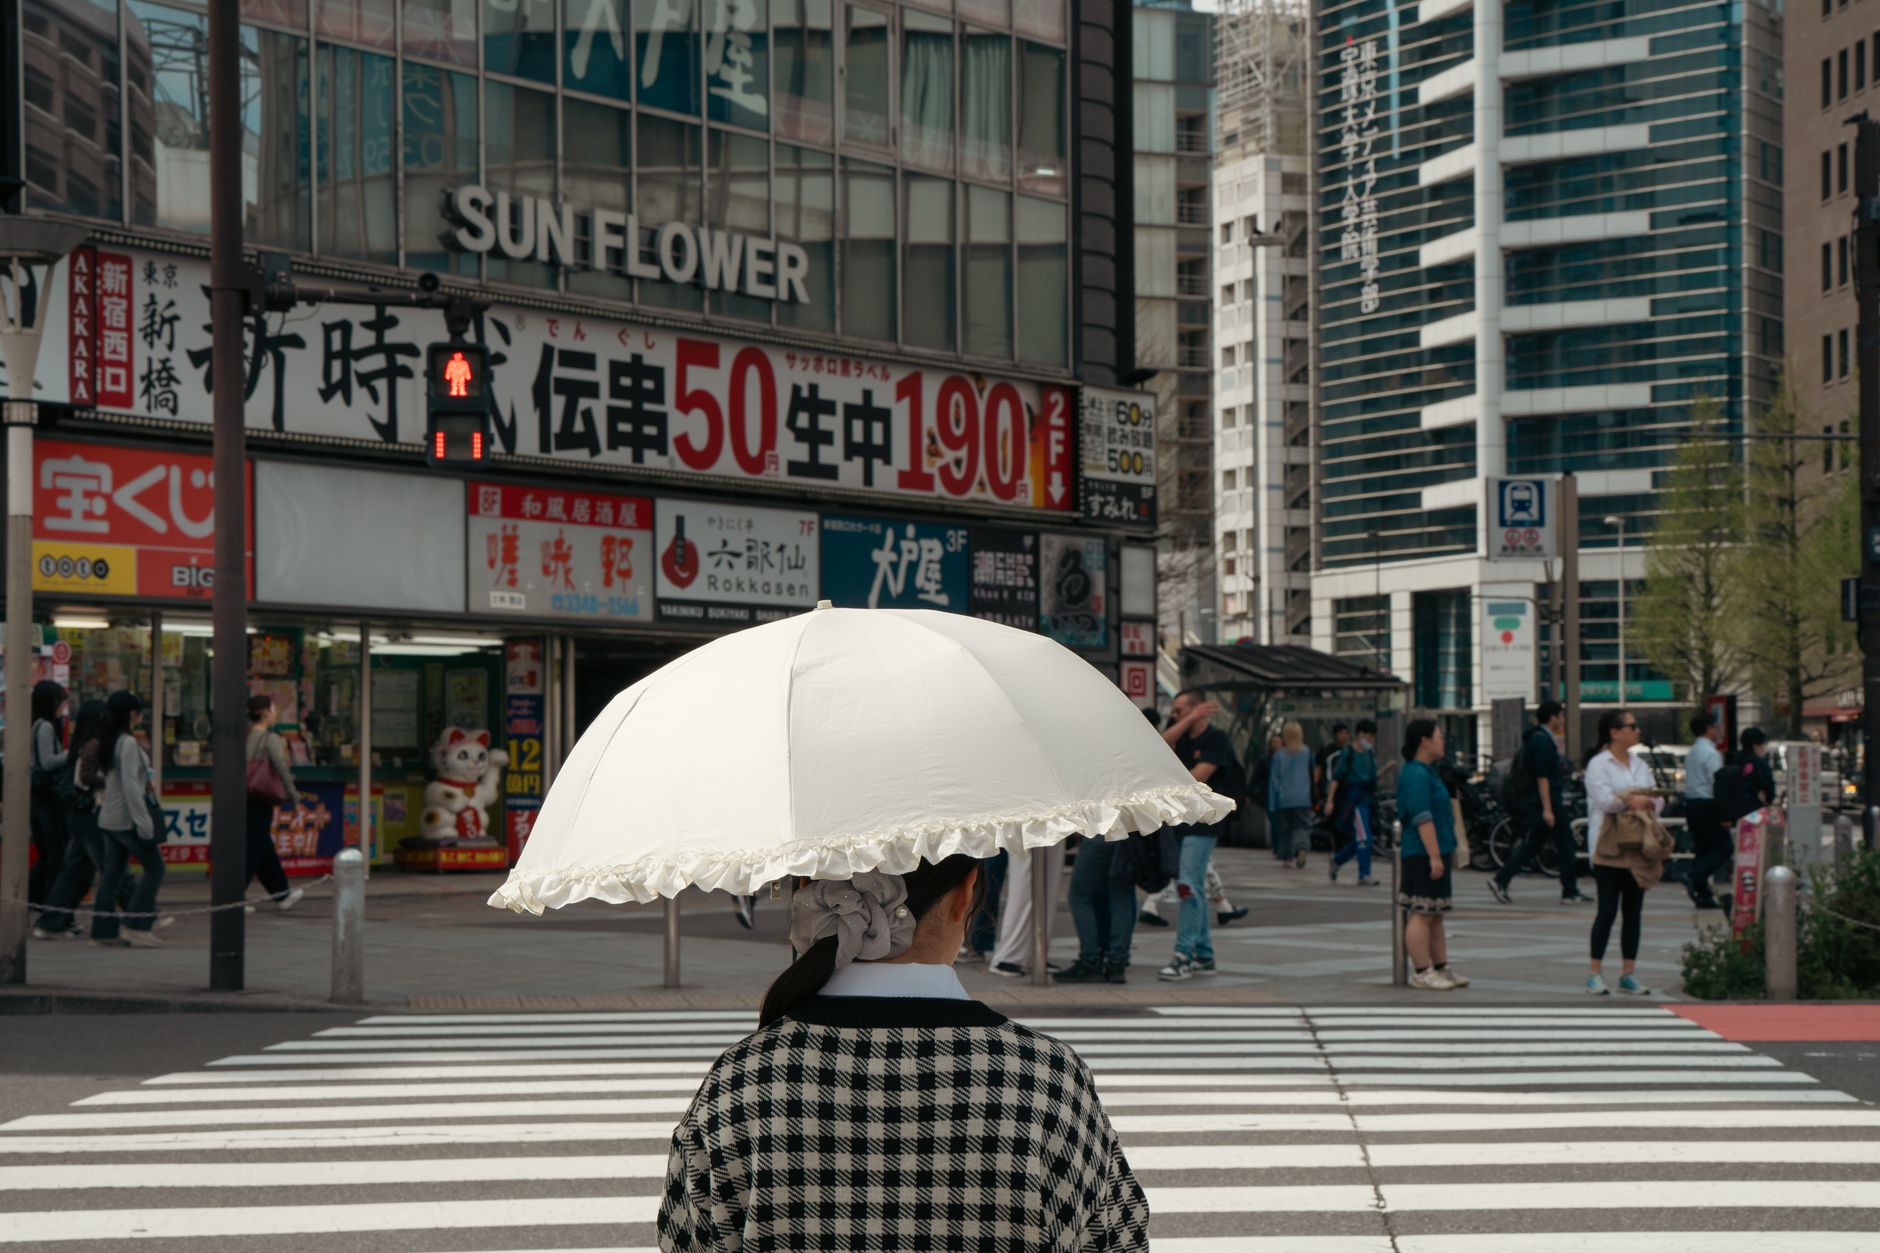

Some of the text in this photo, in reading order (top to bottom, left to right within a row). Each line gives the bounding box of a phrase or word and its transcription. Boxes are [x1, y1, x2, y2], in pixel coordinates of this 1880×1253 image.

[455, 185, 810, 304] SUN FLOWER
[142, 260, 178, 289] 東京
[73, 254, 89, 401] AKAKARA
[102, 261, 128, 394] 新宿西口
[547, 319, 656, 350] でんぐし
[140, 293, 182, 416] 新橋
[785, 352, 892, 383] サッポロ黒ラベル
[532, 343, 669, 464] 伝串
[786, 383, 892, 488] 生中
[1046, 392, 1065, 467] 2F
[40, 454, 215, 539] 宝くじ
[521, 493, 639, 528] 和風居酒屋
[1087, 493, 1139, 521] すみれ
[799, 520, 815, 537] 7F
[946, 530, 968, 553] 3F
[40, 555, 109, 580] toto
[707, 539, 806, 576] 六歌仙
[867, 523, 950, 608] 大戸屋
[707, 574, 810, 598] Rokkasen
[507, 738, 541, 771] 12
